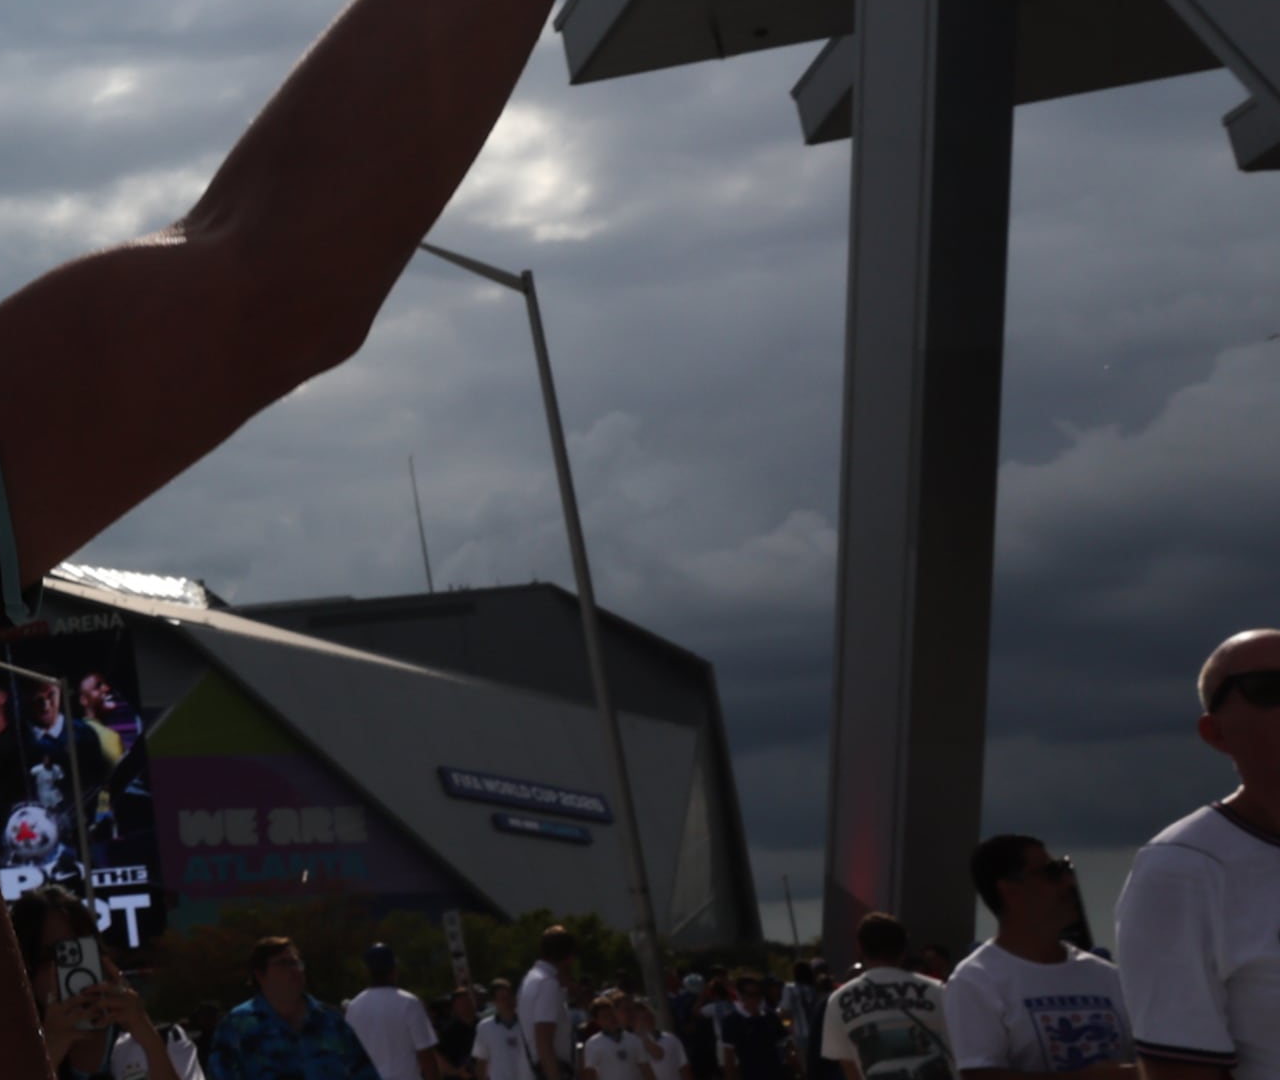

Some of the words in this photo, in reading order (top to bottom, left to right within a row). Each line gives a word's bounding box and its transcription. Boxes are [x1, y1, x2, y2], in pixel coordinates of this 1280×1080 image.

[50, 612, 126, 636] ARENA
[177, 807, 259, 848] WE
[92, 865, 148, 887] THE
[183, 851, 369, 883] ATLANTA
[839, 982, 928, 1009] CHEVY
